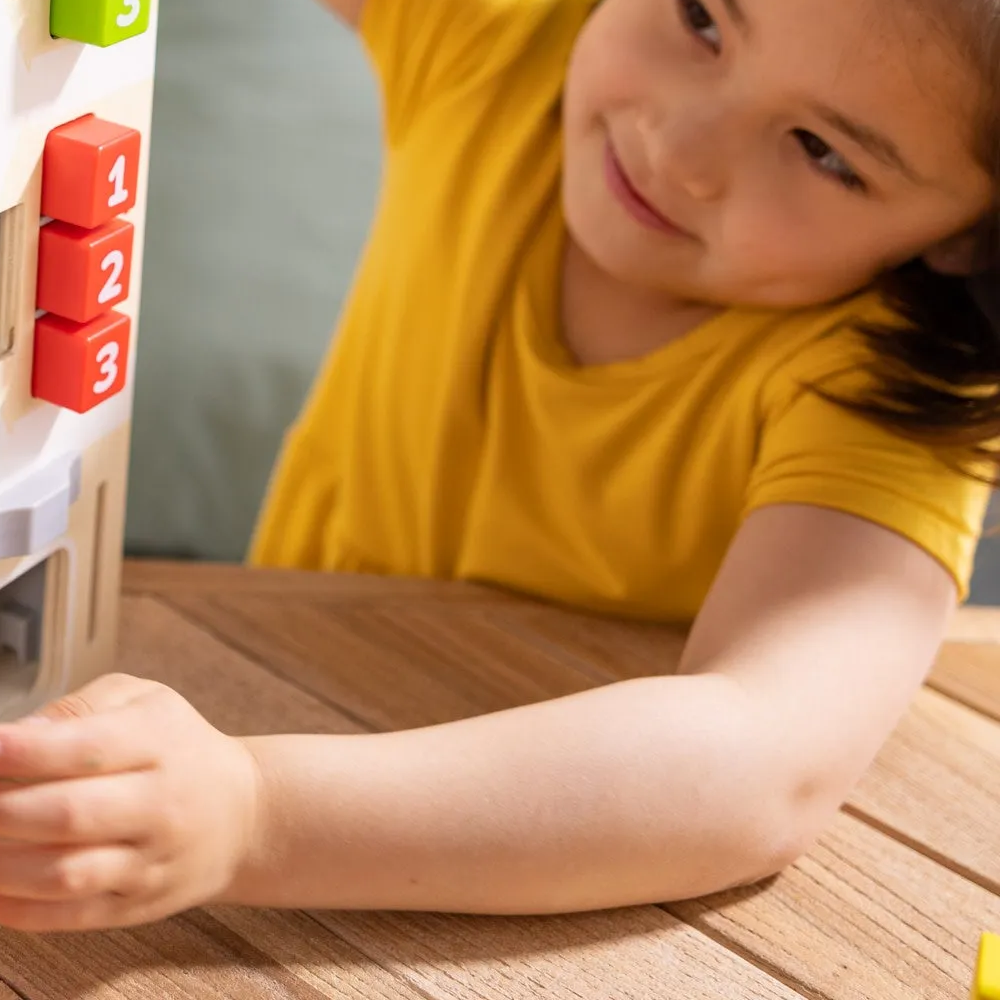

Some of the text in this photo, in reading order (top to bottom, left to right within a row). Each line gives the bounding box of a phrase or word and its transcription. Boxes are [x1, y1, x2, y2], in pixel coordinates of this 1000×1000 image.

[107, 154, 129, 208] 1
[97, 249, 125, 304] 2
[92, 341, 120, 394] 3
